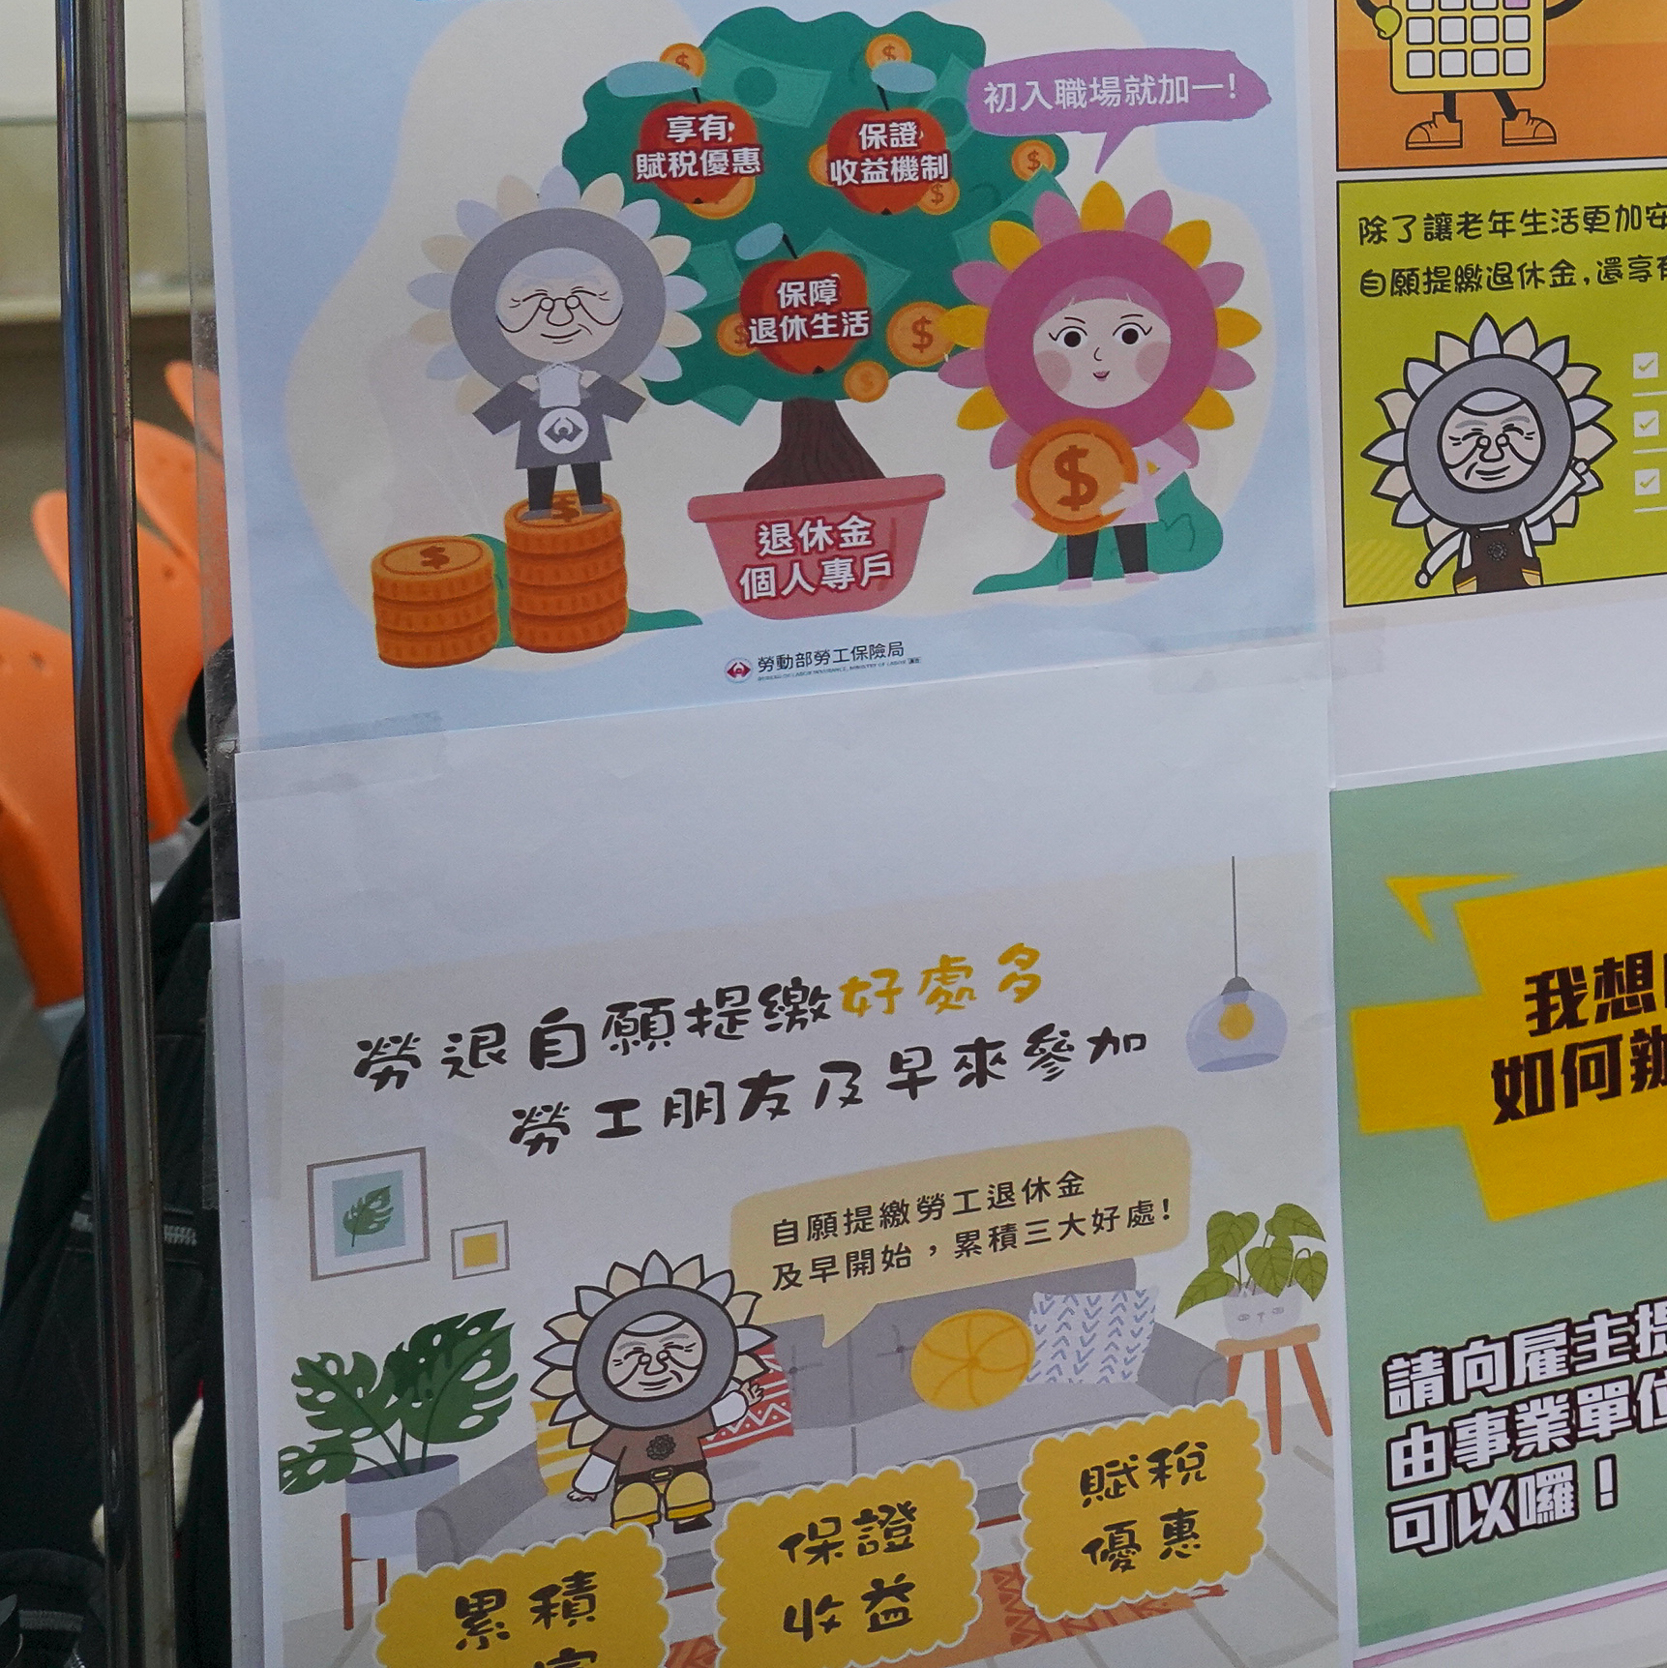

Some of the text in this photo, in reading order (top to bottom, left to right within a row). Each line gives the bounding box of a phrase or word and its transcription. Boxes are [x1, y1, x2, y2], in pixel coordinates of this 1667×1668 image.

[666, 112, 729, 144] 享有
[858, 120, 919, 151] 保證
[829, 152, 950, 187] 收益機制
[777, 277, 838, 309] 保障
[748, 309, 871, 346] 退休生活
[757, 514, 875, 557] 退休金
[740, 554, 894, 599] 個人專戶
[757, 640, 905, 673] 勞動部勞工保險局
[353, 941, 1043, 1094] 勞退自願提繳好處多
[507, 1021, 1148, 1158] 勞工朋友及早來參加
[772, 1169, 1087, 1249] 自願提繳勞工退休金
[778, 1501, 918, 1567] 保證
[1080, 1507, 1201, 1573] 優惠
[454, 1569, 598, 1652] 累積
[782, 1574, 916, 1644] 收益
